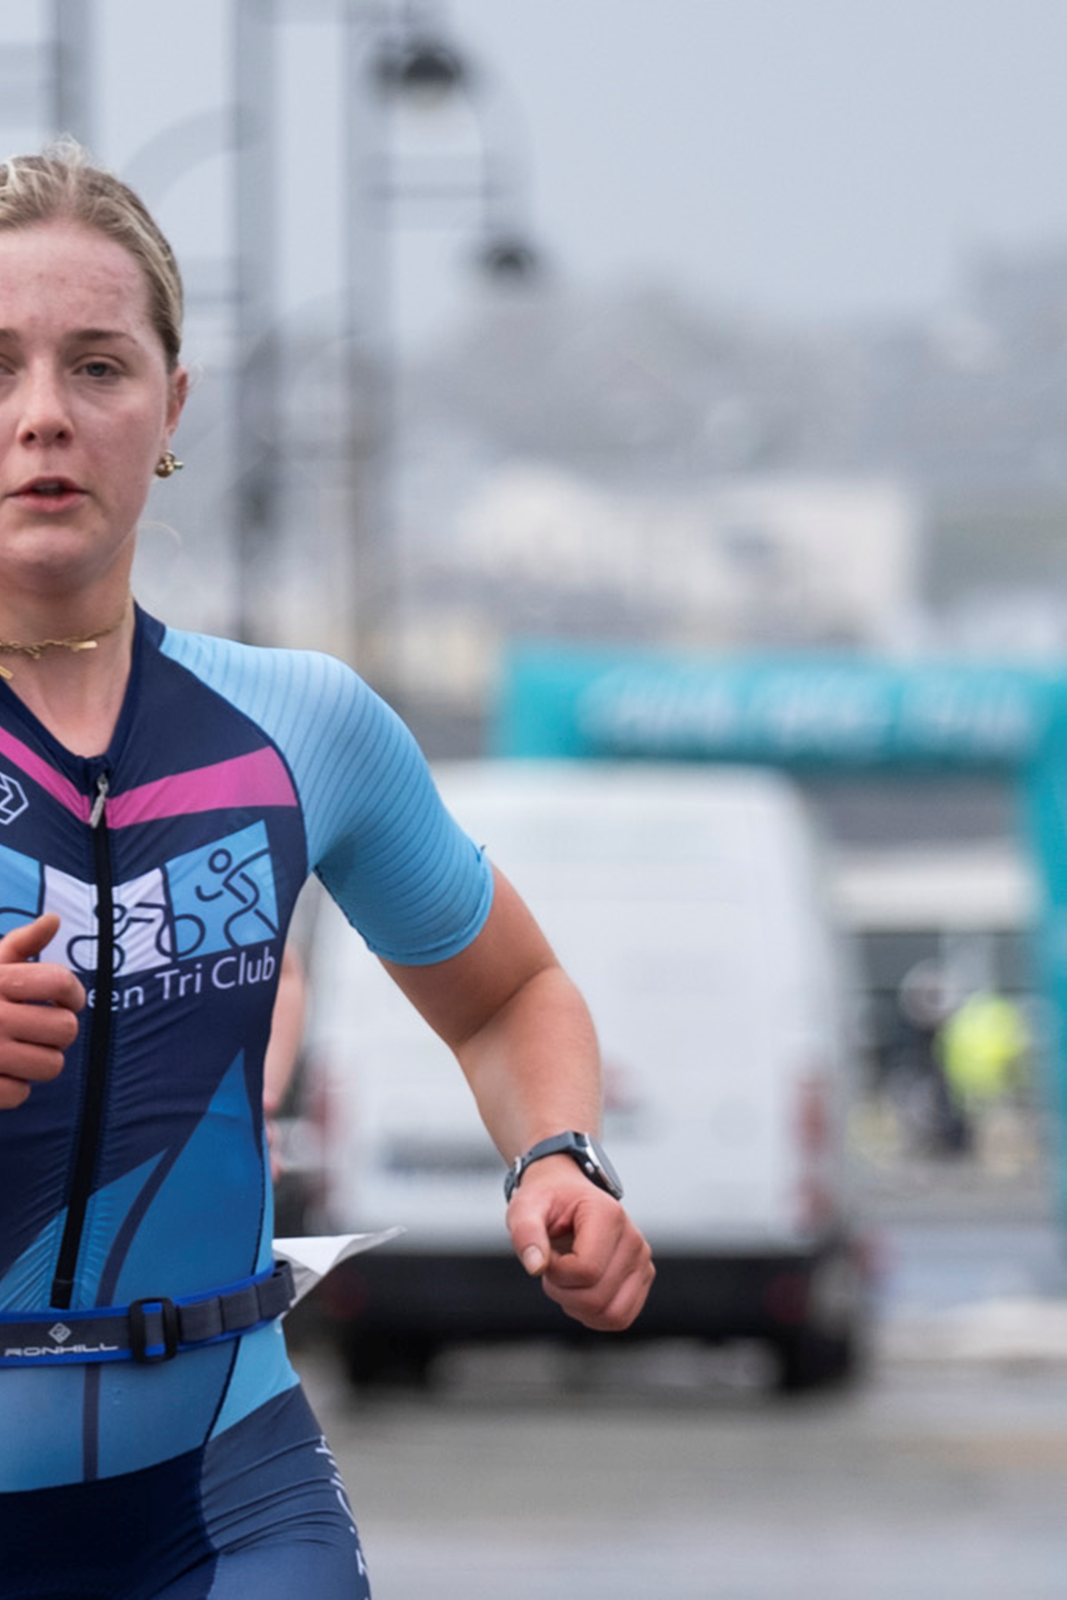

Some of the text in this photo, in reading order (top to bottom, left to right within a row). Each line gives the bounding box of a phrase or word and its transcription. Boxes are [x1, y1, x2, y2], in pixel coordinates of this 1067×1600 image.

[155, 963, 202, 1000] Tri
[211, 946, 275, 989] Club
[4, 1342, 119, 1358] RONHILL
